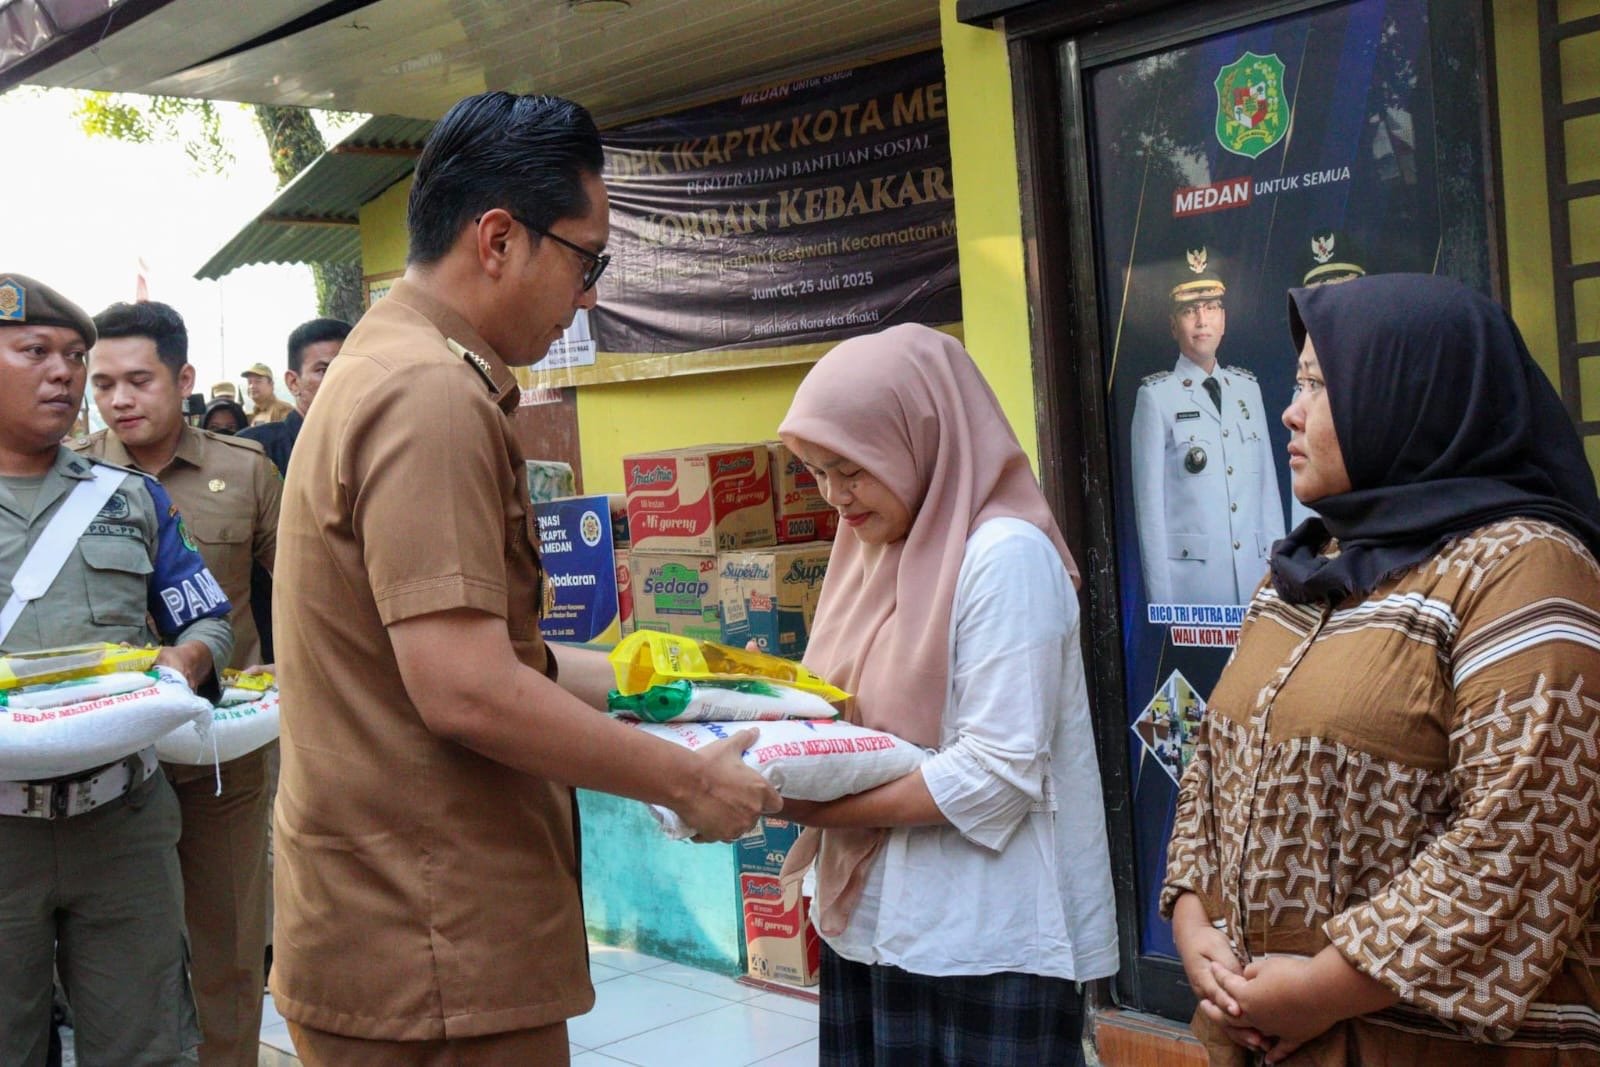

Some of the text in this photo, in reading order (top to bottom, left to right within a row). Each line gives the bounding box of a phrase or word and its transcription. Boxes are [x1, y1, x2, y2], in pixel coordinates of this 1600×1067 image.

[612, 82, 947, 180] DPK IKAPTK KOTA ME
[792, 147, 869, 176] BANTUAN
[874, 135, 931, 161] SOSIAL
[1175, 166, 1351, 213] MEDAN UNTUK SEMUA
[841, 222, 938, 251] Kecamatan
[800, 280, 814, 295] 25
[817, 275, 840, 292] Juli
[842, 271, 874, 289] 2025
[89, 524, 135, 536] POL-PP
[659, 519, 697, 534] goreng
[544, 541, 573, 553] MEDAN
[650, 567, 664, 577] Mie
[160, 568, 229, 627] PAM
[643, 578, 709, 598] Sedaap
[1150, 606, 1172, 621] RICO
[1174, 606, 1190, 622] TRI
[1192, 607, 1223, 623] PUTRA
[1173, 628, 1197, 644] WALI
[1199, 629, 1224, 645] KOTA
[755, 736, 895, 764] BERAS MEDIUM SUPER
